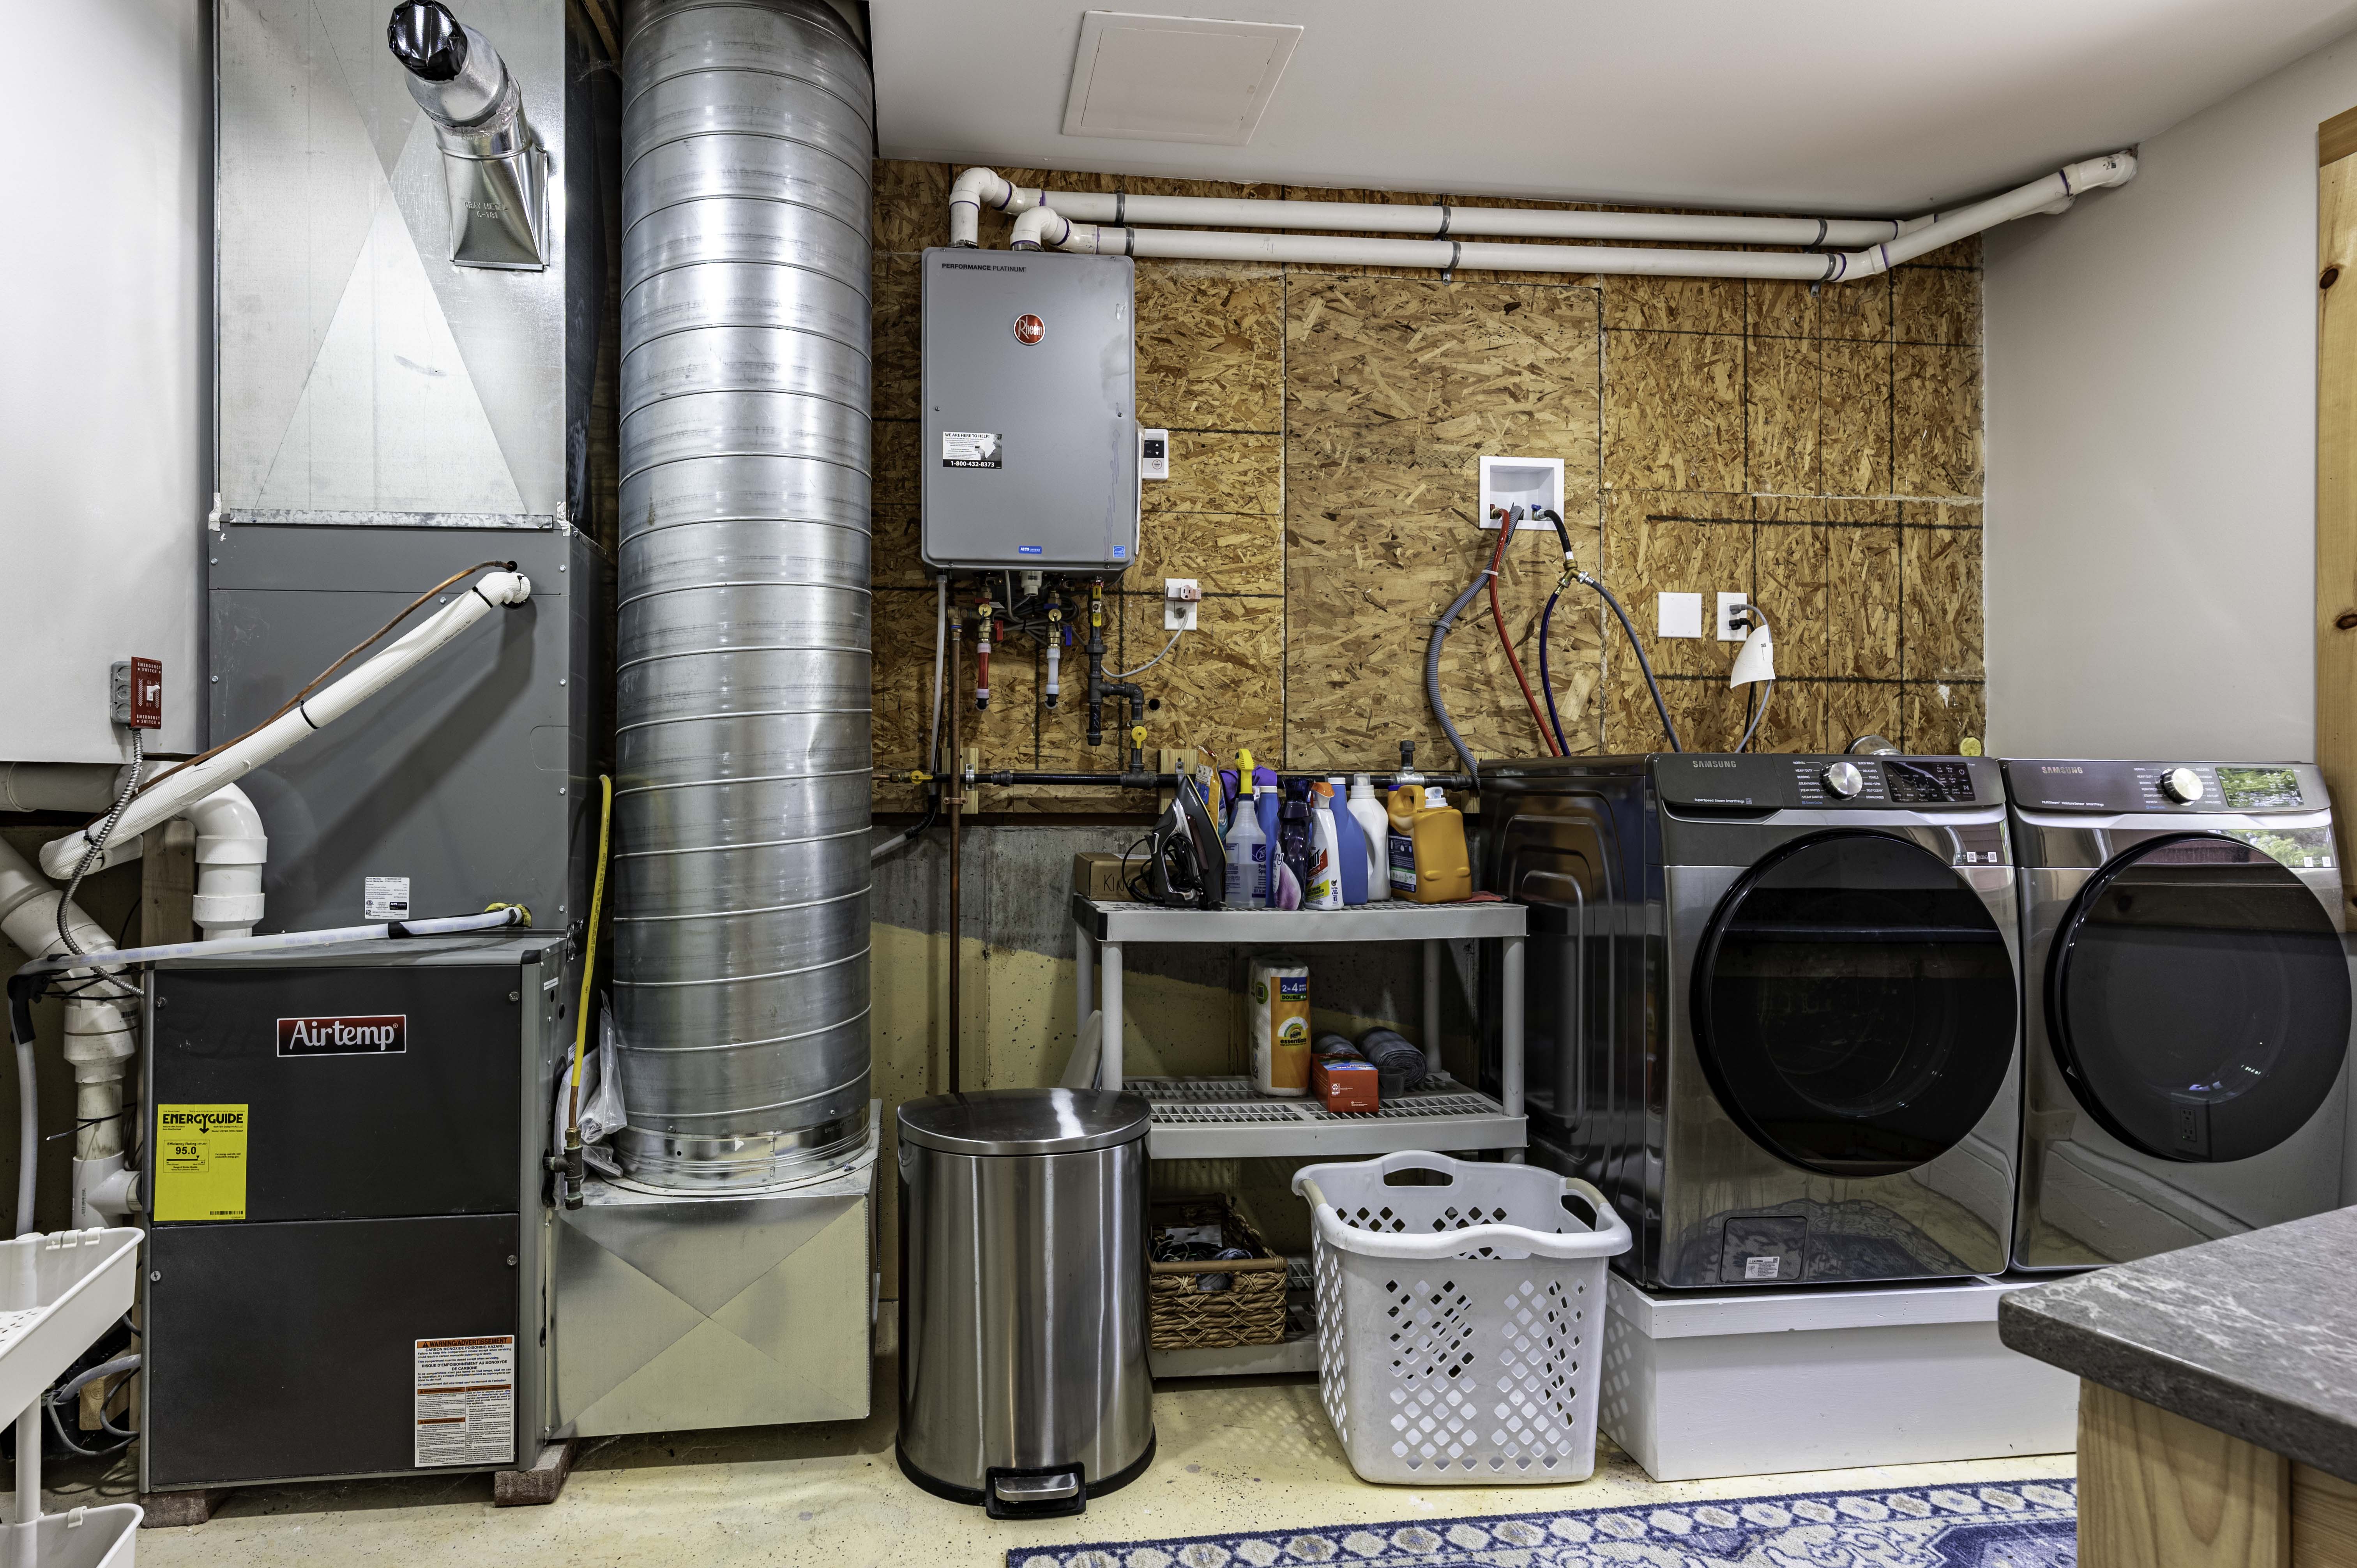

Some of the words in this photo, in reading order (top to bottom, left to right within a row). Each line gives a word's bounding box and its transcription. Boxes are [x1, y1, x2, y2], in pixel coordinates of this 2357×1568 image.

[1018, 316, 1042, 339] Rheem
[290, 1021, 394, 1051] Airtemp
[163, 1113, 243, 1124] ENERGYGUIDE
[429, 1338, 507, 1347] WARNING/ADVERTISSEMENT
